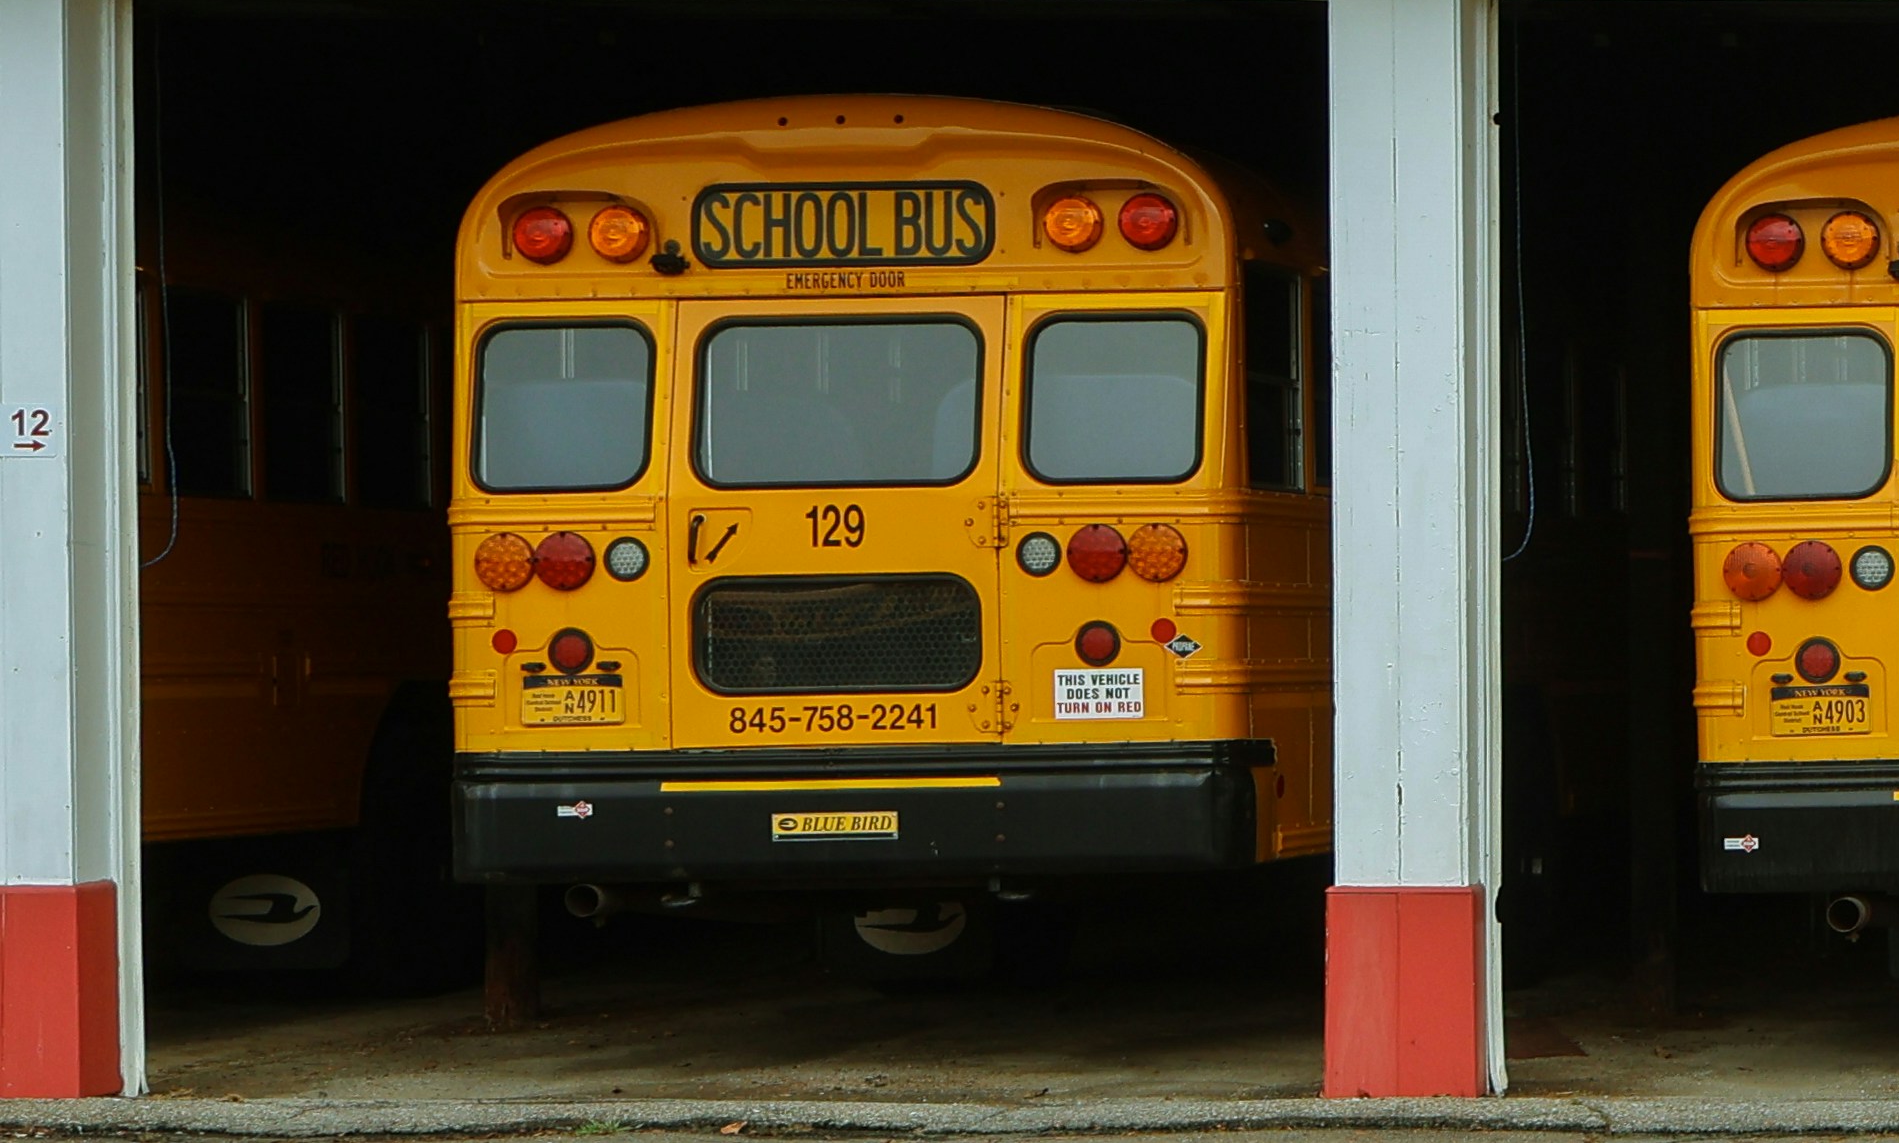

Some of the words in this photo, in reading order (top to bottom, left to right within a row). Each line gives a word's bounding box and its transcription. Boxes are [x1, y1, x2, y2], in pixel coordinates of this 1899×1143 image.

[702, 191, 884, 258] SCHOOL
[894, 189, 984, 257] BUS
[786, 272, 864, 289] EMERGENCY
[869, 271, 905, 288] DOOR
[11, 408, 50, 436] 12
[805, 504, 865, 547] 129
[1057, 674, 1085, 686] THIS
[1090, 673, 1140, 686] VEHICLE
[577, 689, 616, 713] 4911
[1066, 688, 1100, 700] DOES
[1105, 687, 1131, 699] NOT
[729, 703, 937, 733] 845-758-2241
[1057, 702, 1090, 713] TURN
[1095, 702, 1112, 713] ON
[1118, 701, 1141, 713] RED
[1825, 699, 1865, 723] 4903
[802, 816, 846, 832] BLUE
[851, 815, 892, 830] BIRD
